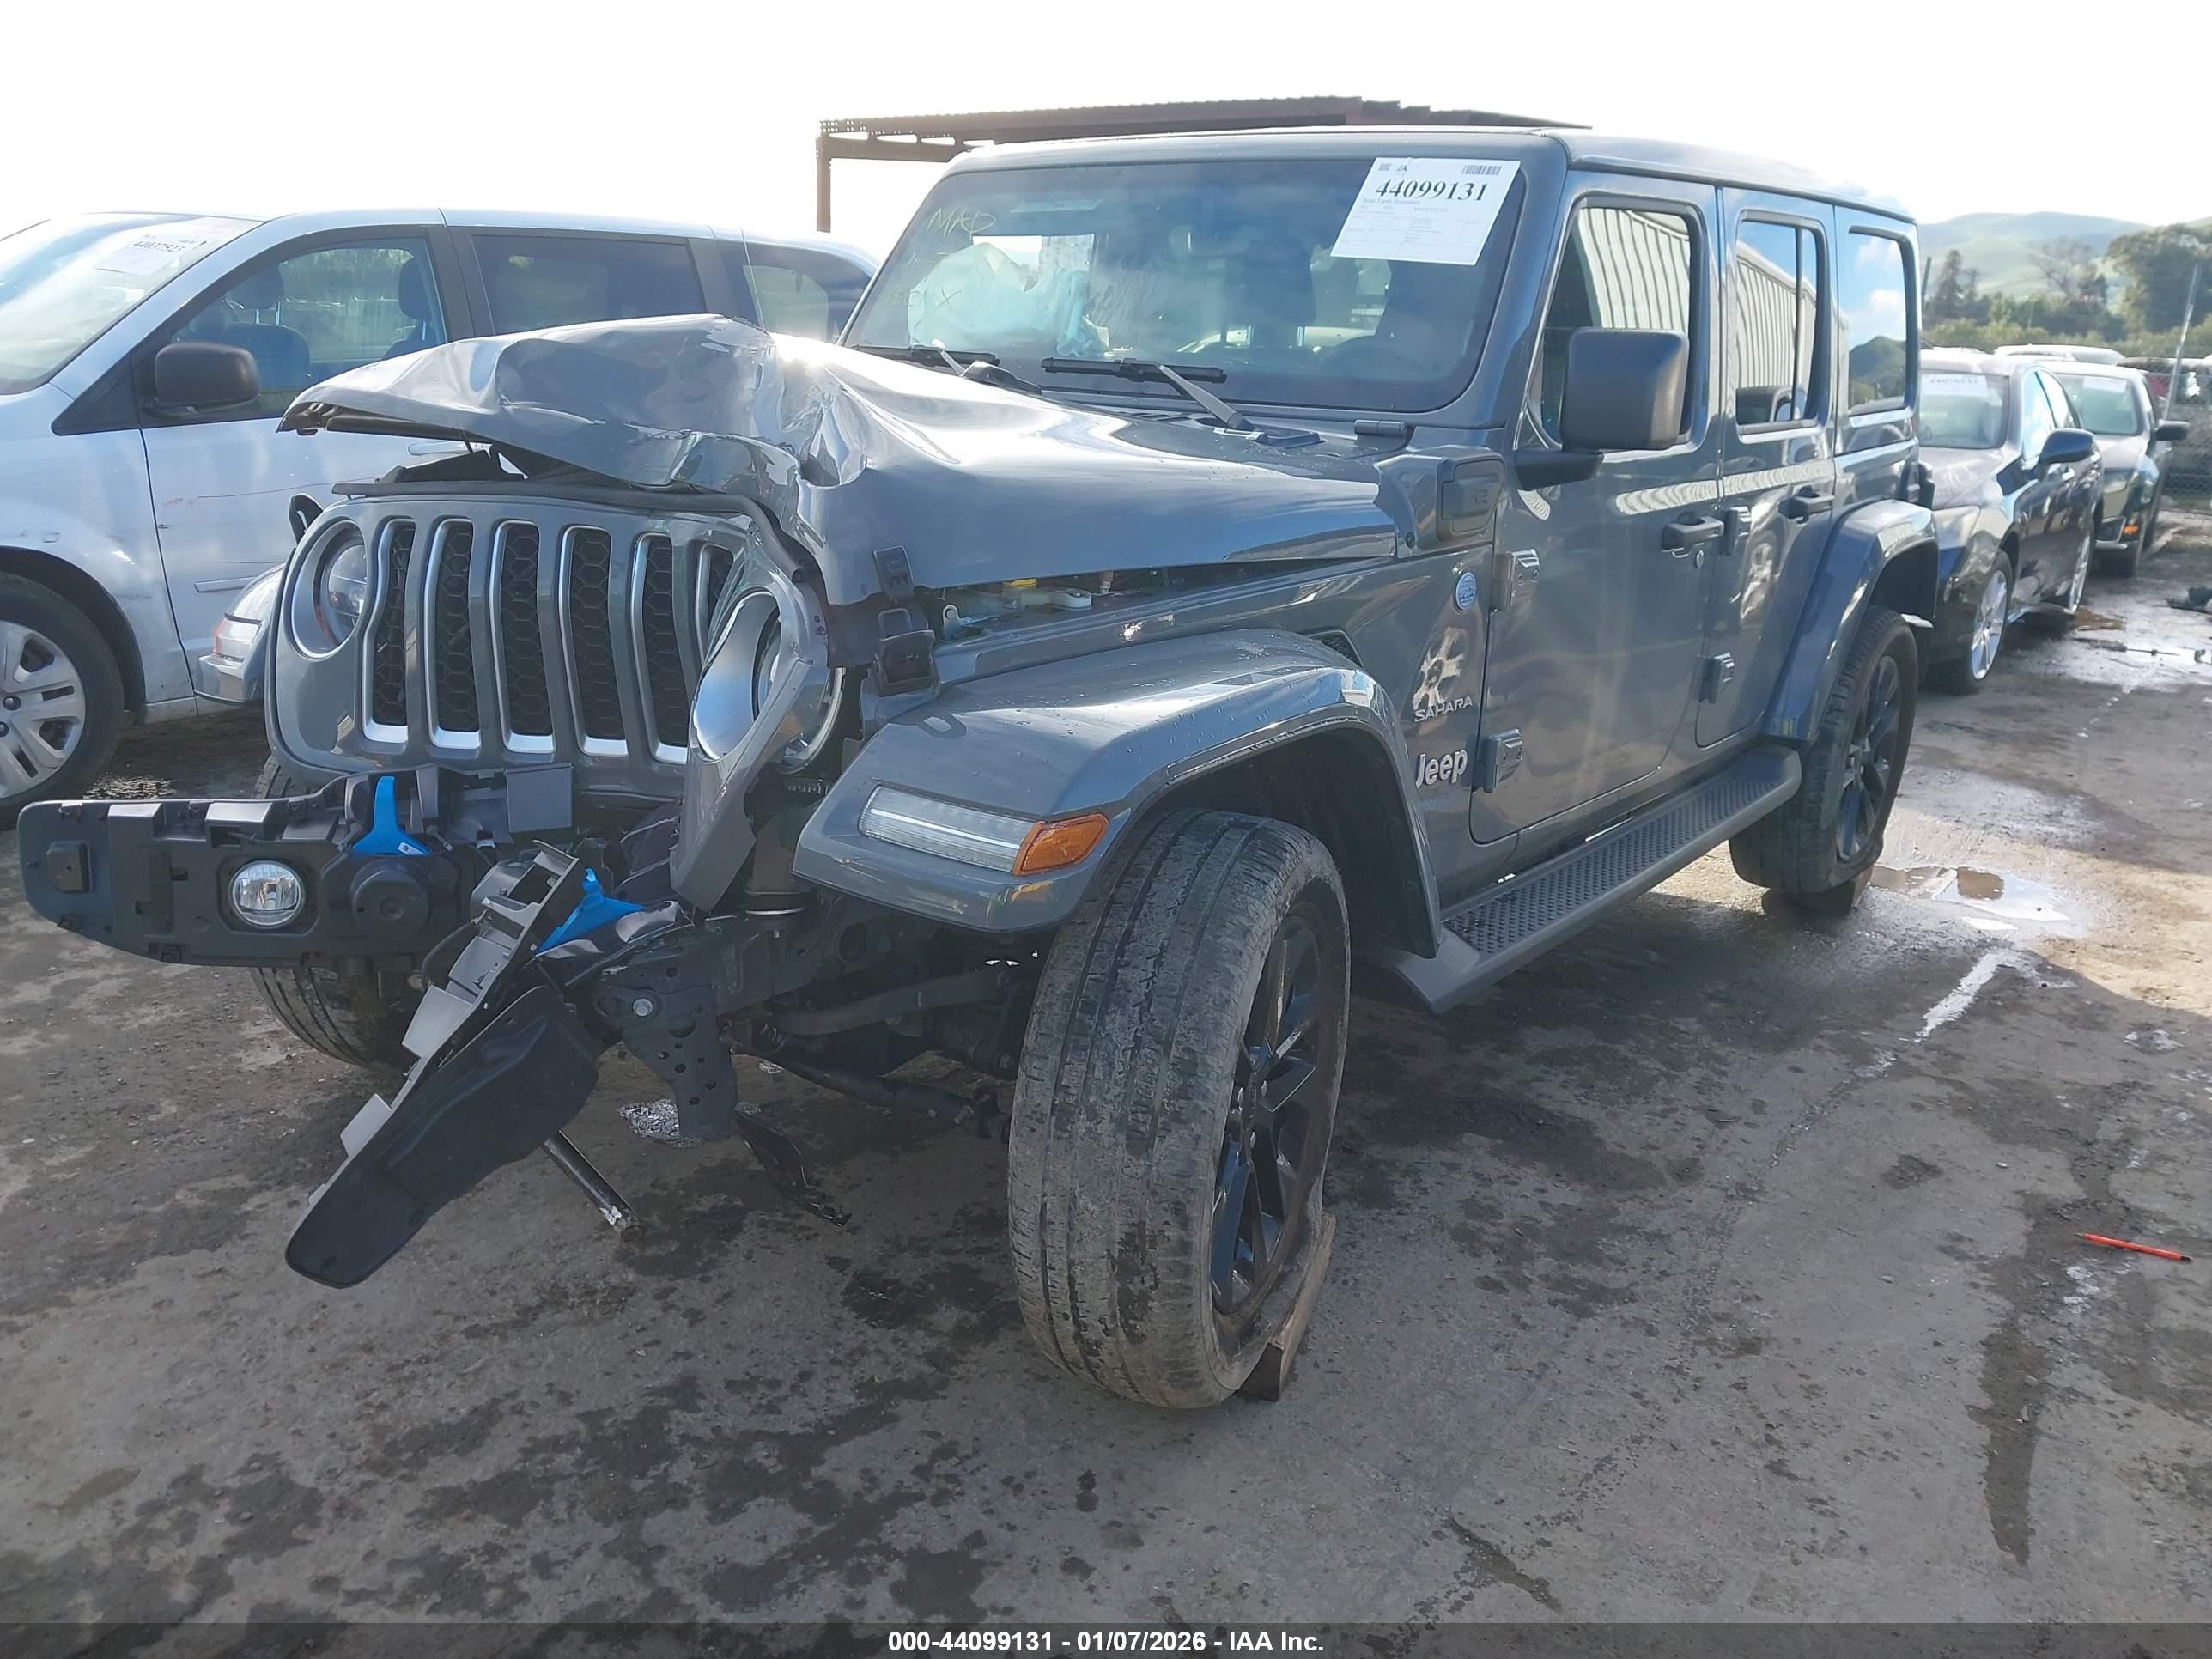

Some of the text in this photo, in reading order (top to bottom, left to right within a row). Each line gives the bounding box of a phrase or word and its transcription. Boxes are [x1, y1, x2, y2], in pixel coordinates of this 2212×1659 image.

[1375, 179, 1488, 202] 44099131
[1414, 696, 1474, 722] SAHARA
[1415, 749, 1468, 789] Jeep
